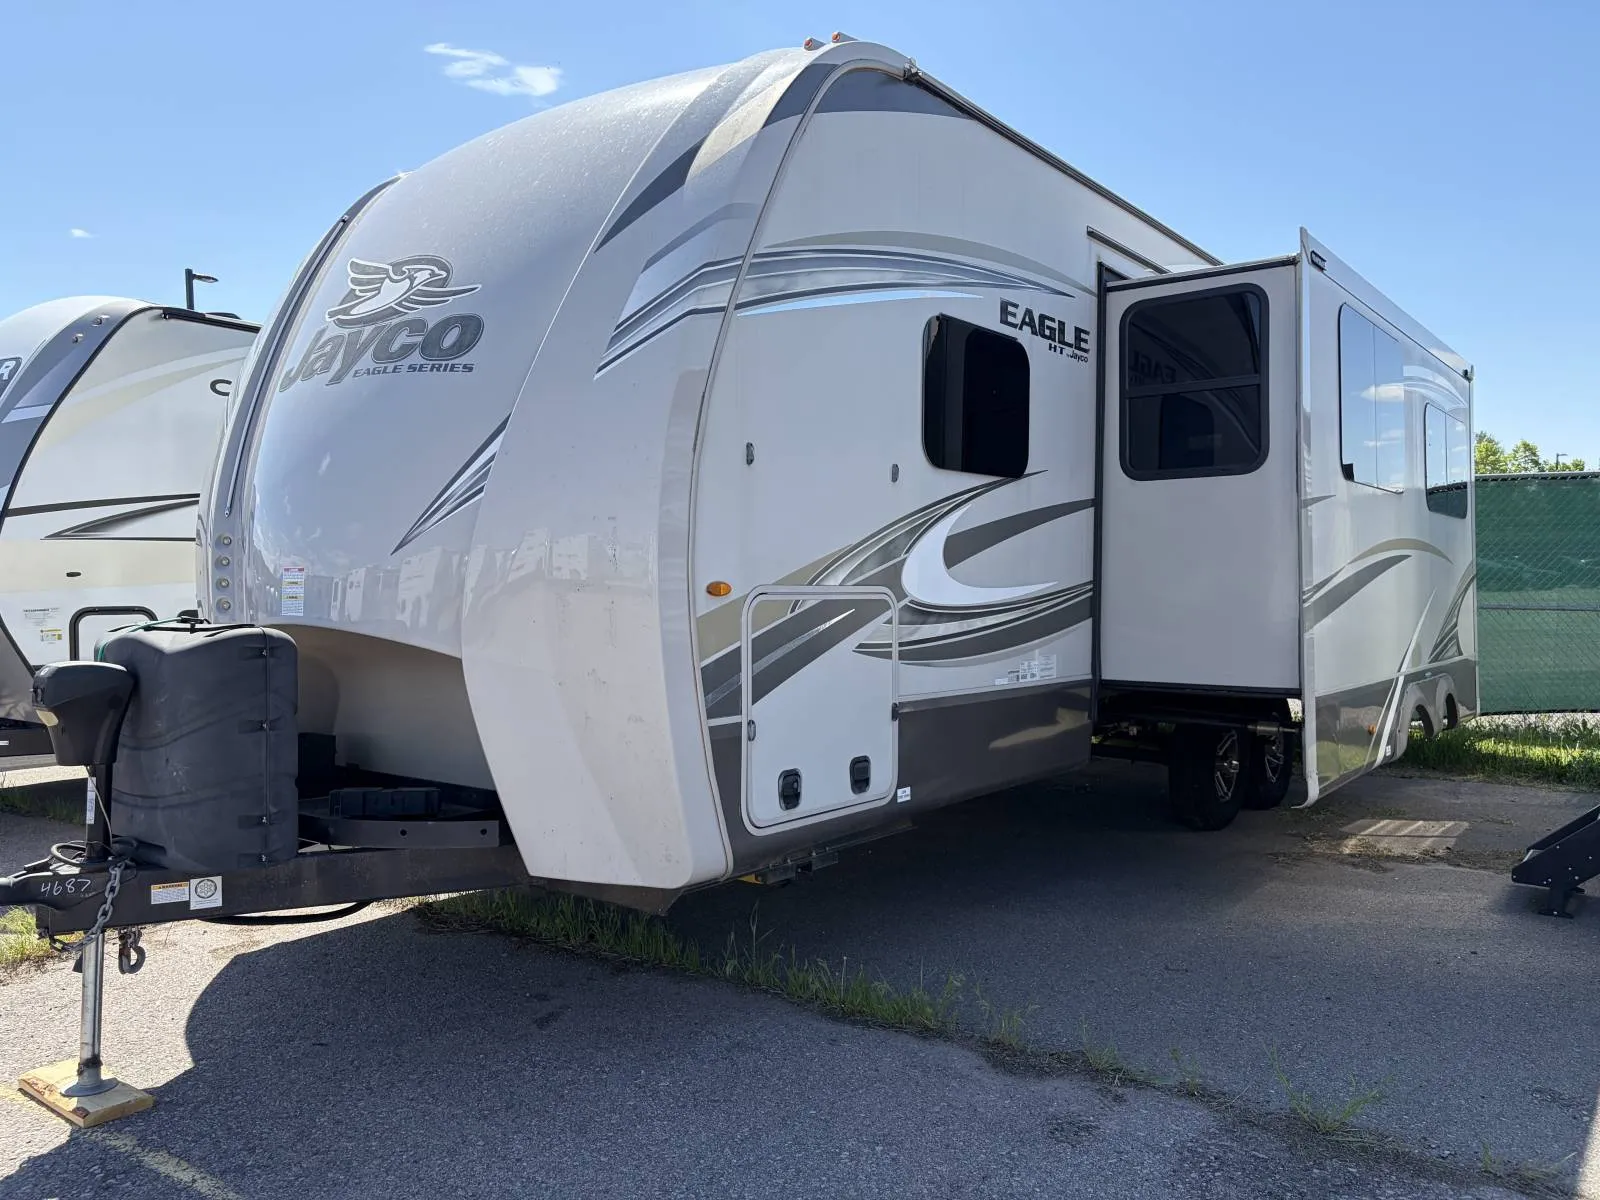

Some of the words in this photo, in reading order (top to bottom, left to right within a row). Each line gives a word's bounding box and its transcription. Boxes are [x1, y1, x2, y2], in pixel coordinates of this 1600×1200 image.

[1000, 297, 1090, 354] EAGLE
[1048, 342, 1066, 355] HT
[352, 364, 404, 379] EAGLE
[406, 363, 475, 374] SERIES
[41, 878, 91, 897] 4687
